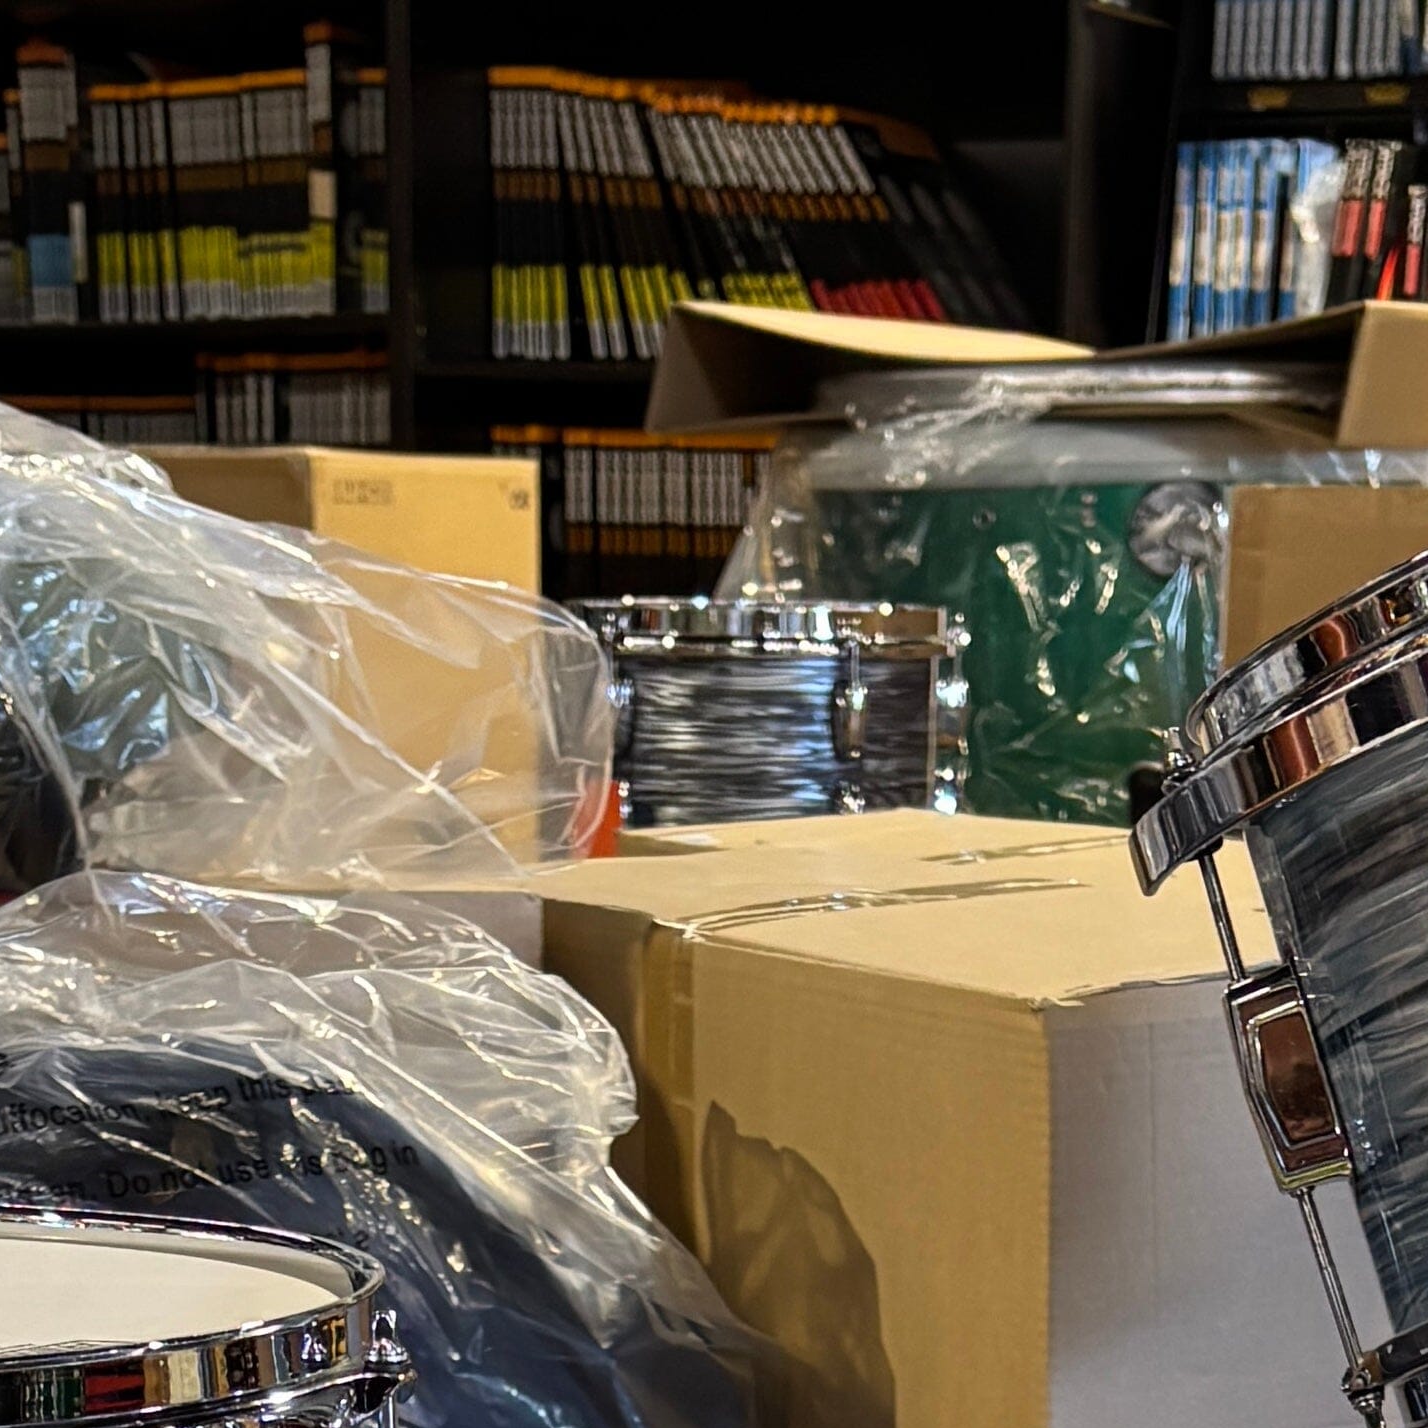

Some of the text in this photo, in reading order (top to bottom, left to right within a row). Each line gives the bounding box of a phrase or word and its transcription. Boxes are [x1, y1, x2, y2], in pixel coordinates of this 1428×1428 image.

[237, 1072, 293, 1103] this
[107, 1167, 150, 1198] Do
[218, 1154, 269, 1184] use
[392, 1138, 421, 1167] in
